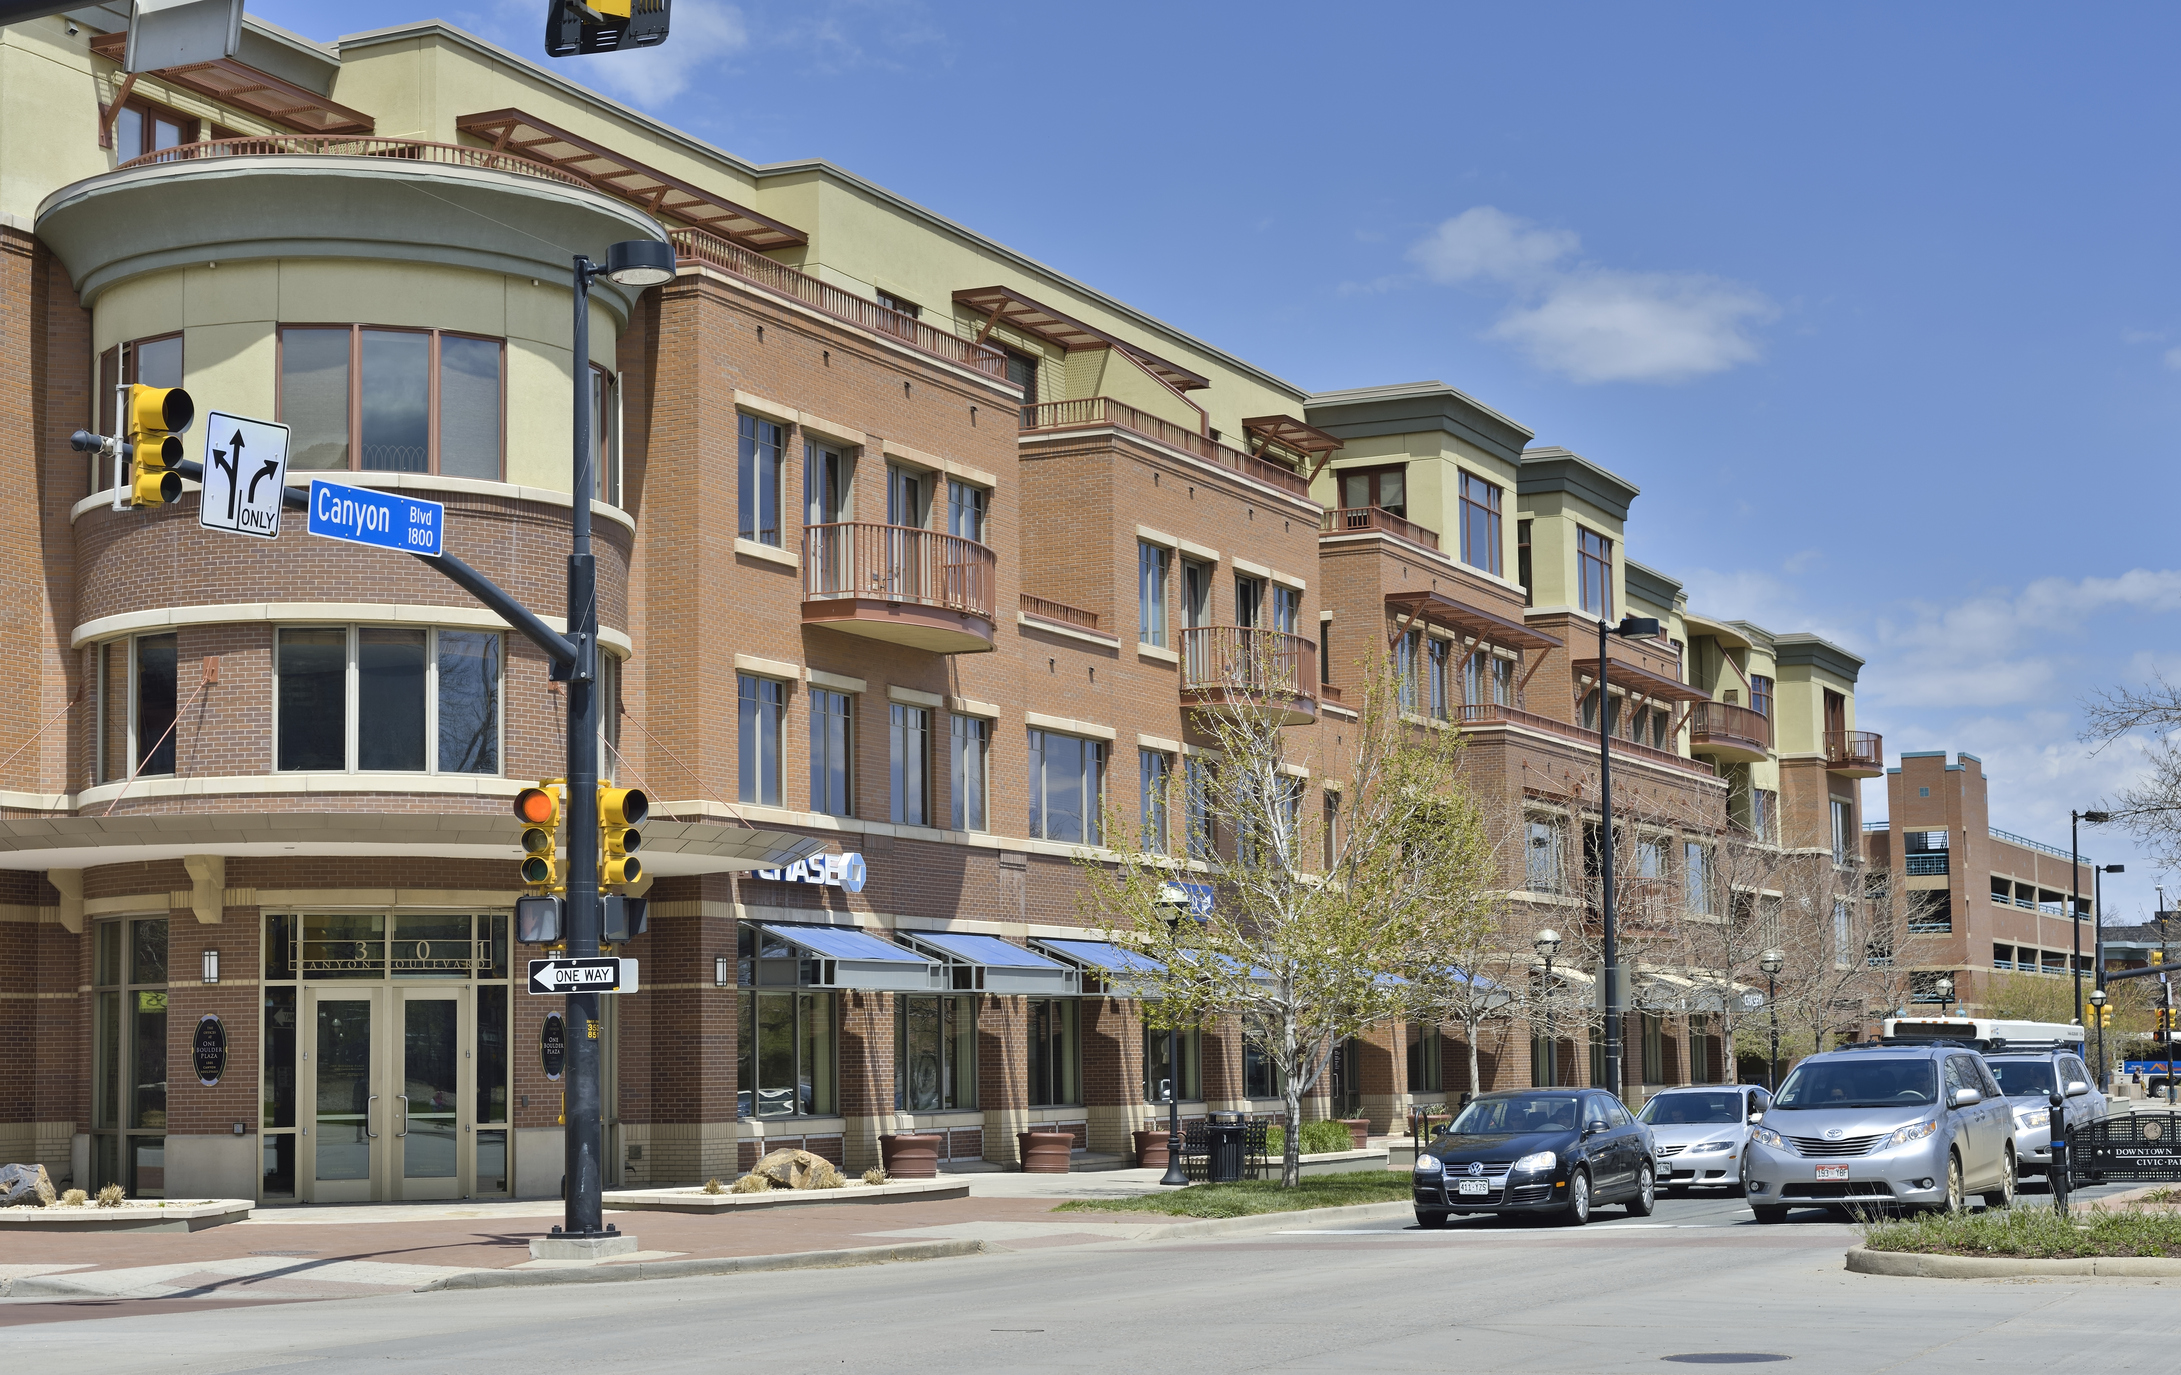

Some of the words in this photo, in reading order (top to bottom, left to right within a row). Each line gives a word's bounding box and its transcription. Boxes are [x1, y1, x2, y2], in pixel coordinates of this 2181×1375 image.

[241, 508, 276, 530] ONLY
[318, 487, 390, 537] Canyon
[409, 506, 432, 526] Blvd
[408, 528, 434, 547] 1800
[555, 969, 580, 983] ONE
[584, 968, 610, 981] WAY
[2115, 1148, 2173, 1156] DOWNTOWN
